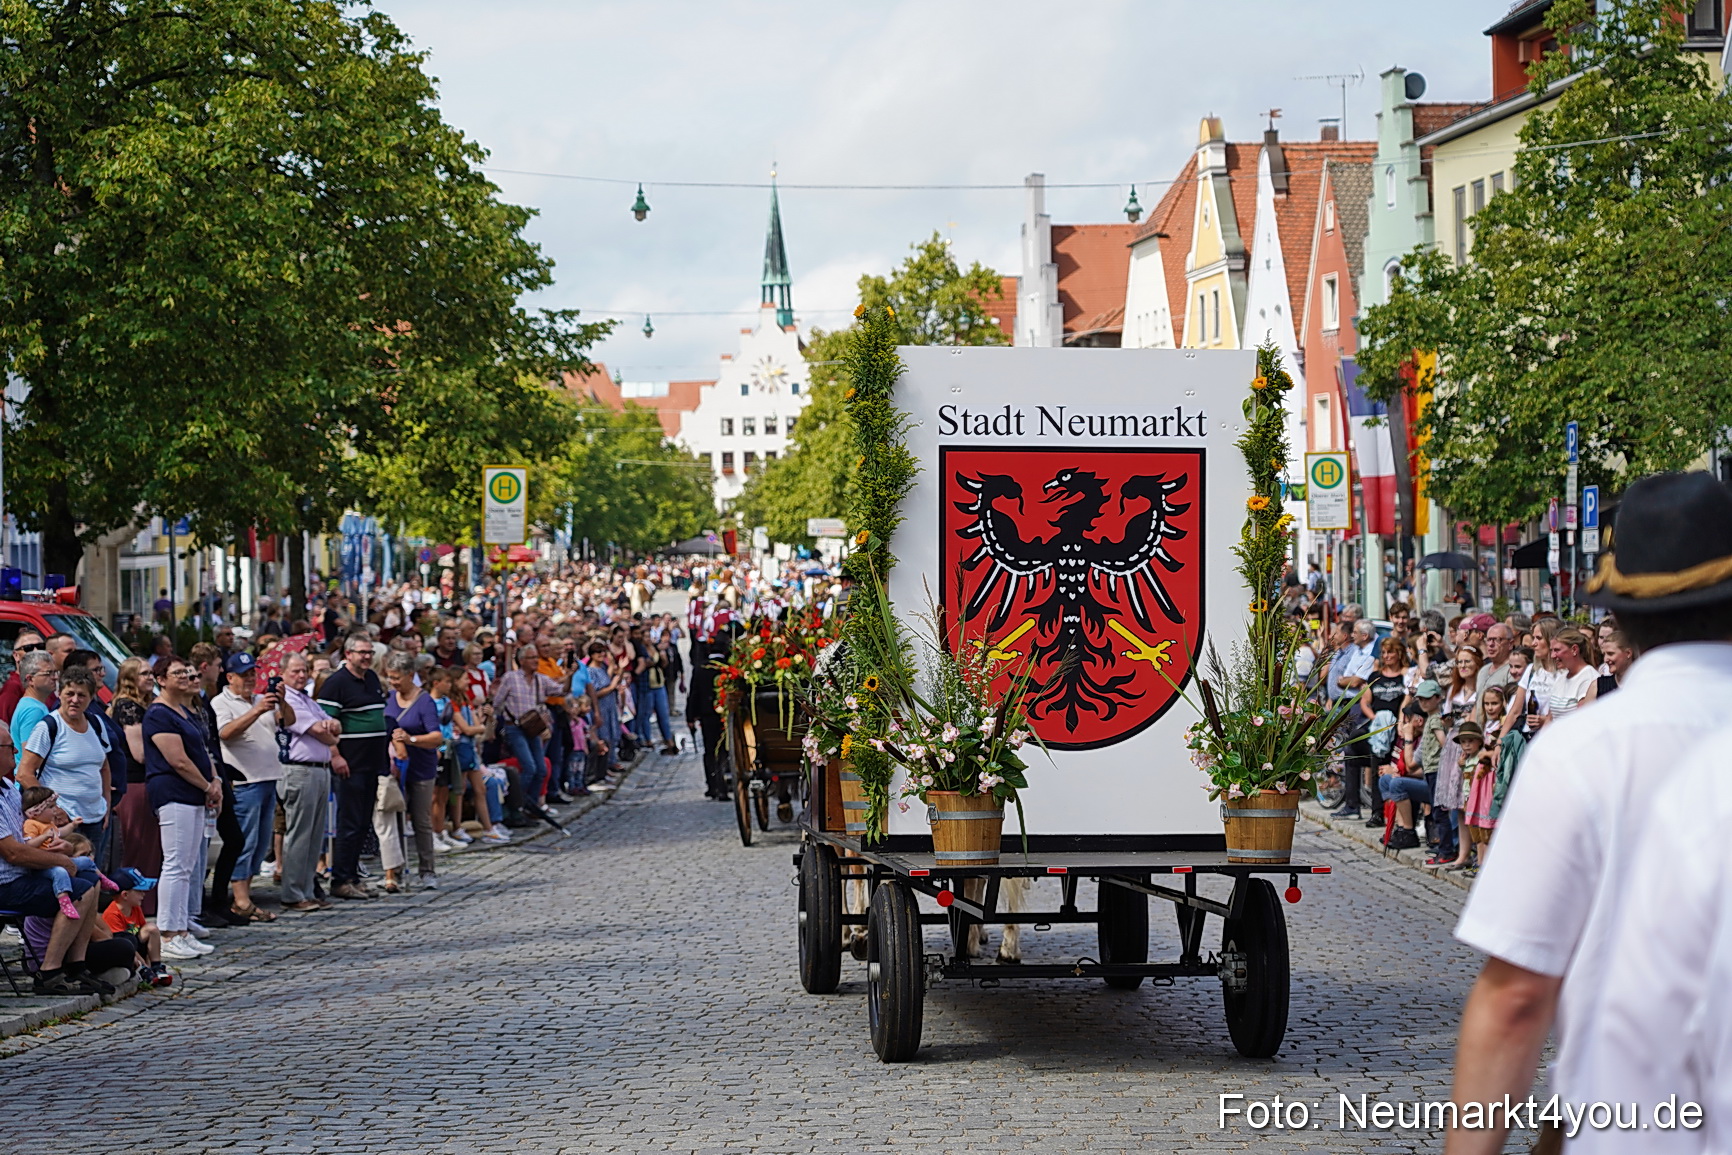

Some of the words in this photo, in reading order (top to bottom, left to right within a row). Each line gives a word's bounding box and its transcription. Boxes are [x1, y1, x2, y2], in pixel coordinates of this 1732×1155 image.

[938, 404, 1026, 437] Stadt
[1035, 404, 1208, 438] Neumarkt
[1568, 427, 1576, 458] P
[498, 478, 512, 497] H
[1320, 464, 1335, 482] H
[1586, 491, 1595, 524] P
